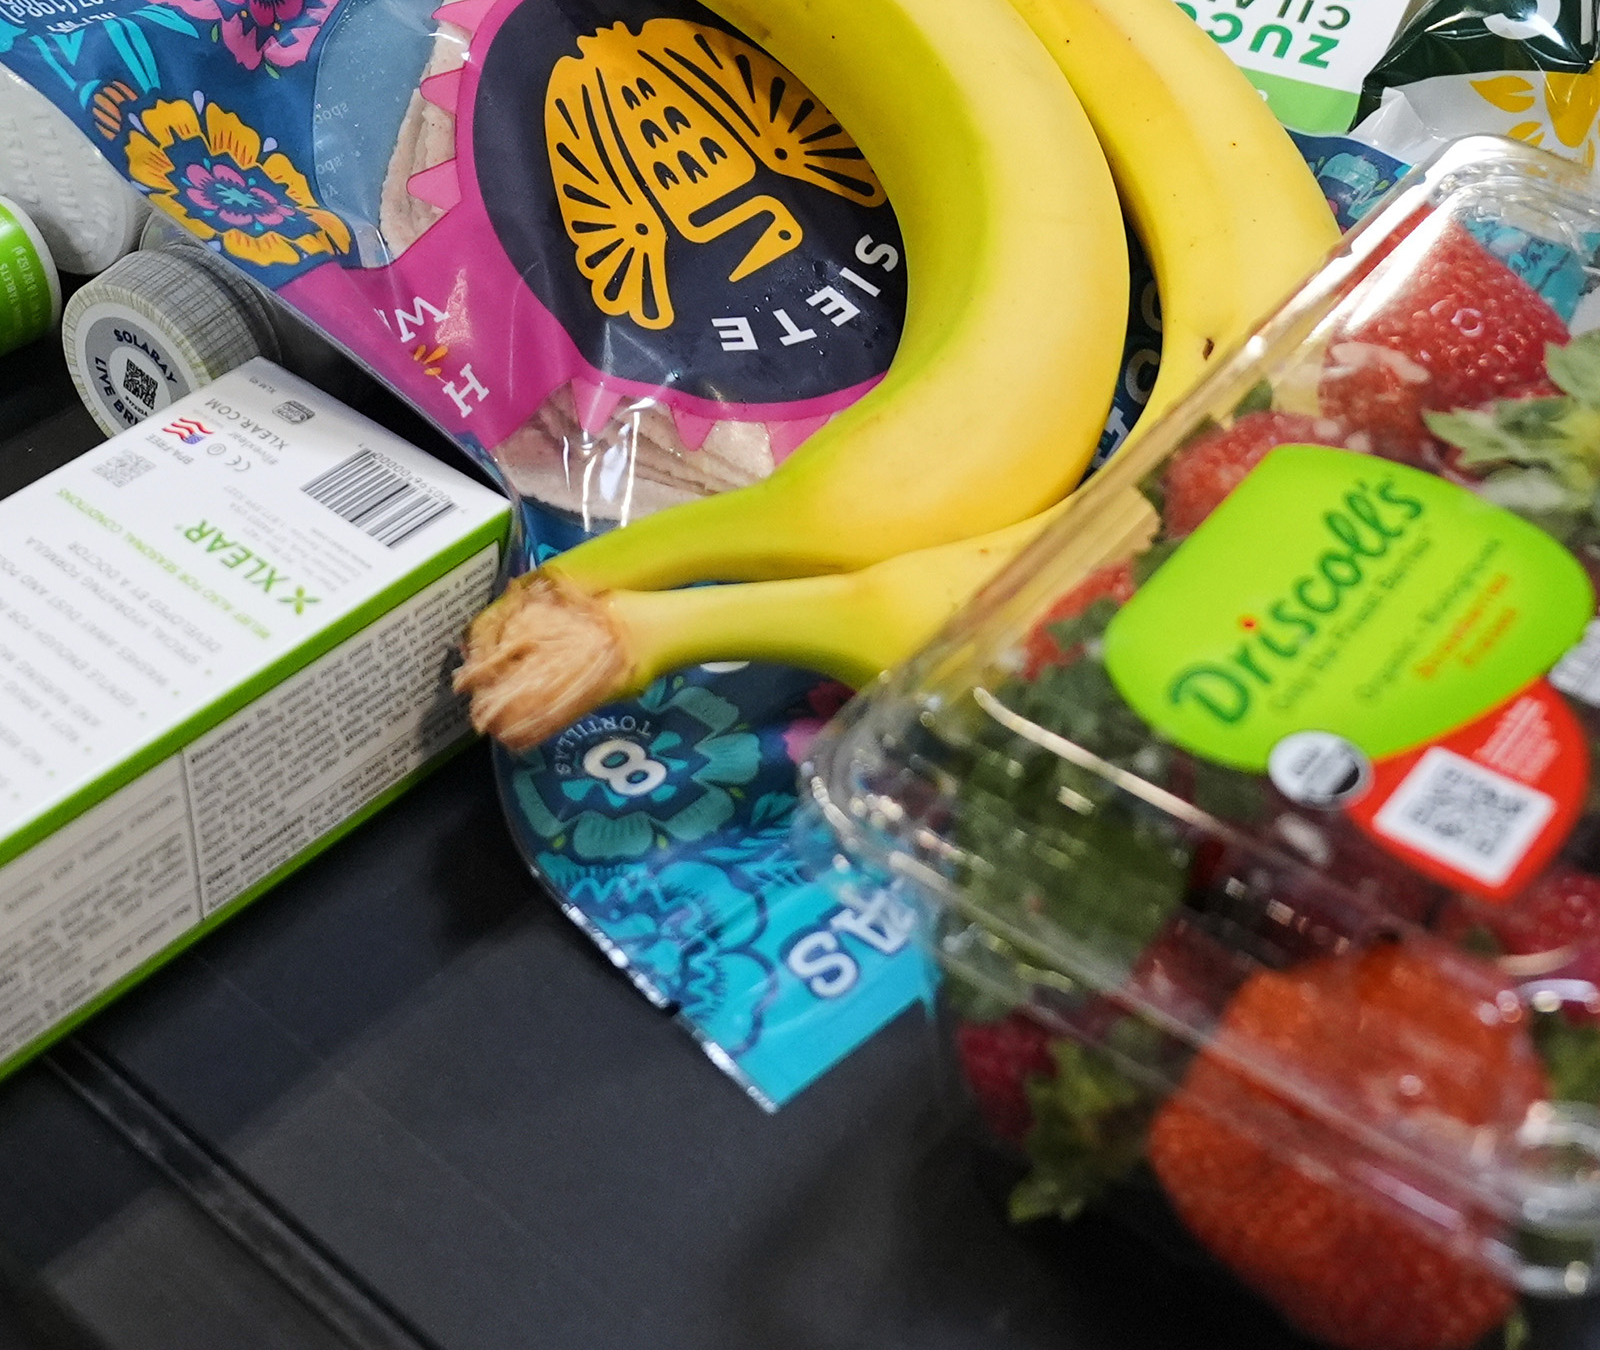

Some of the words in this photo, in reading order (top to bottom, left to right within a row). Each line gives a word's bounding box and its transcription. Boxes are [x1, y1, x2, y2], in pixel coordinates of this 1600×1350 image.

[711, 232, 899, 351] SIETE
[95, 357, 116, 396] LIVE
[113, 329, 178, 383] SOLARAY
[144, 434, 194, 465] BPA-FREE
[204, 397, 290, 452] XLEAR.COM
[227, 431, 278, 466] #livexlear
[184, 518, 291, 594] XLEAR
[1169, 477, 1425, 726] Driscoll's
[552, 713, 653, 777] TORTILLAS
[582, 739, 667, 796] 8
